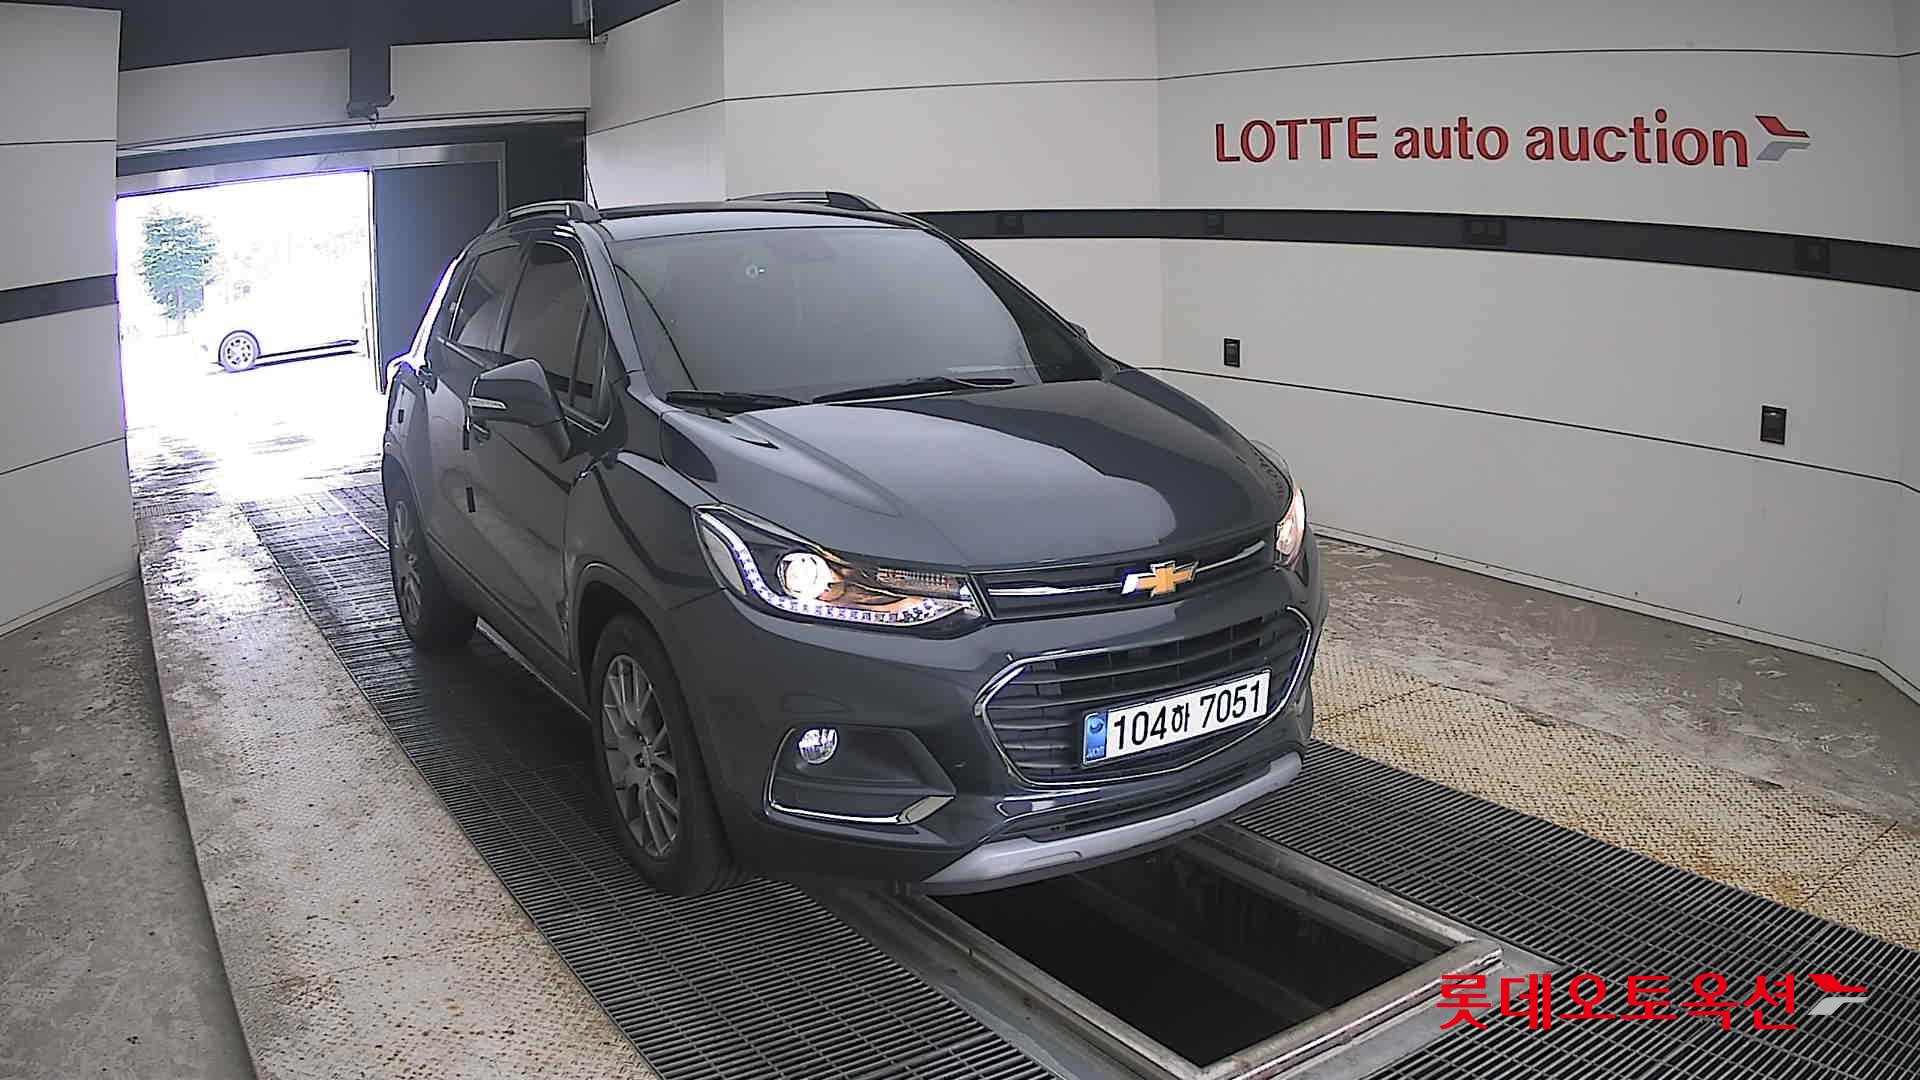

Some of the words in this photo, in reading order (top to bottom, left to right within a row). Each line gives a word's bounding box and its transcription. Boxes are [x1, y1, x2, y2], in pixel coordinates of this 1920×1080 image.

[1215, 115, 1378, 163] LOTTE
[1393, 116, 1511, 161] auto
[1525, 108, 1750, 168] auction
[1113, 702, 1190, 750] 104하
[1199, 679, 1261, 729] 7051
